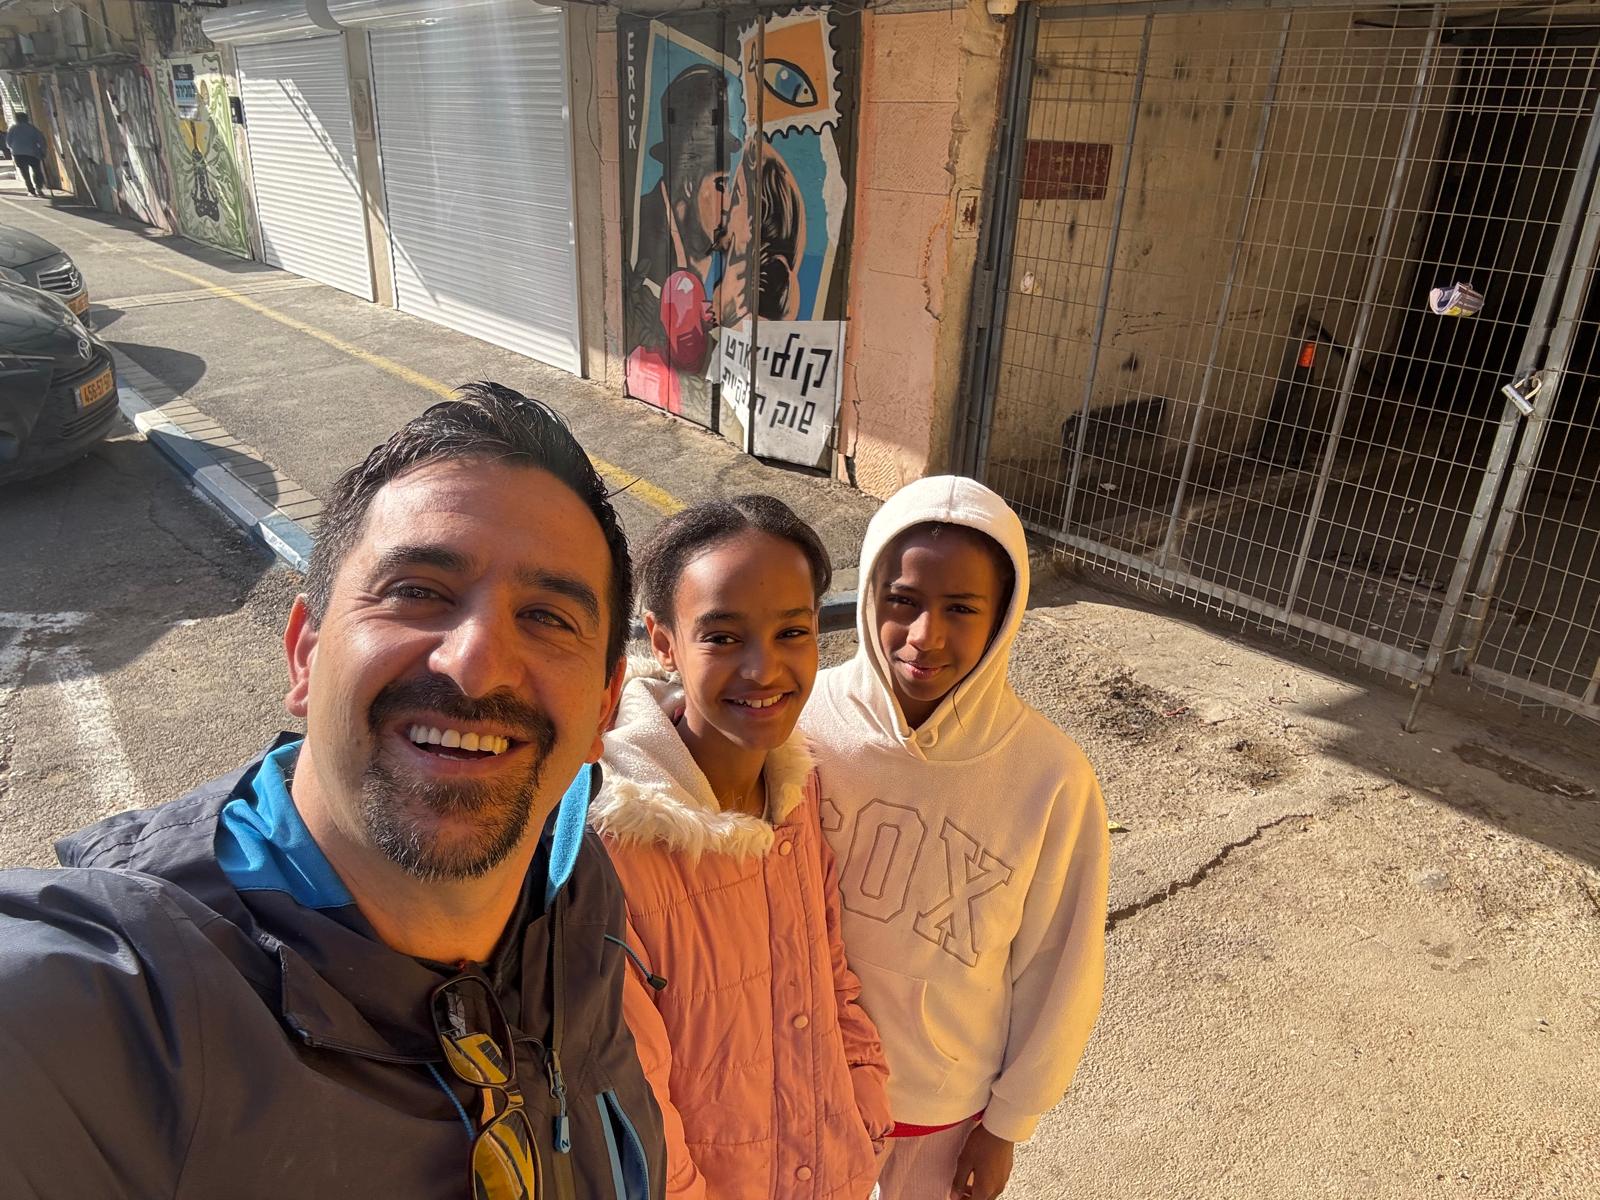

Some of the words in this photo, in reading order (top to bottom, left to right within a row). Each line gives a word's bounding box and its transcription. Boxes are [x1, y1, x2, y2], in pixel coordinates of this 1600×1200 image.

[627, 31, 637, 149] ERCK
[769, 400, 816, 435] שוק
[820, 798, 1015, 968] OX
